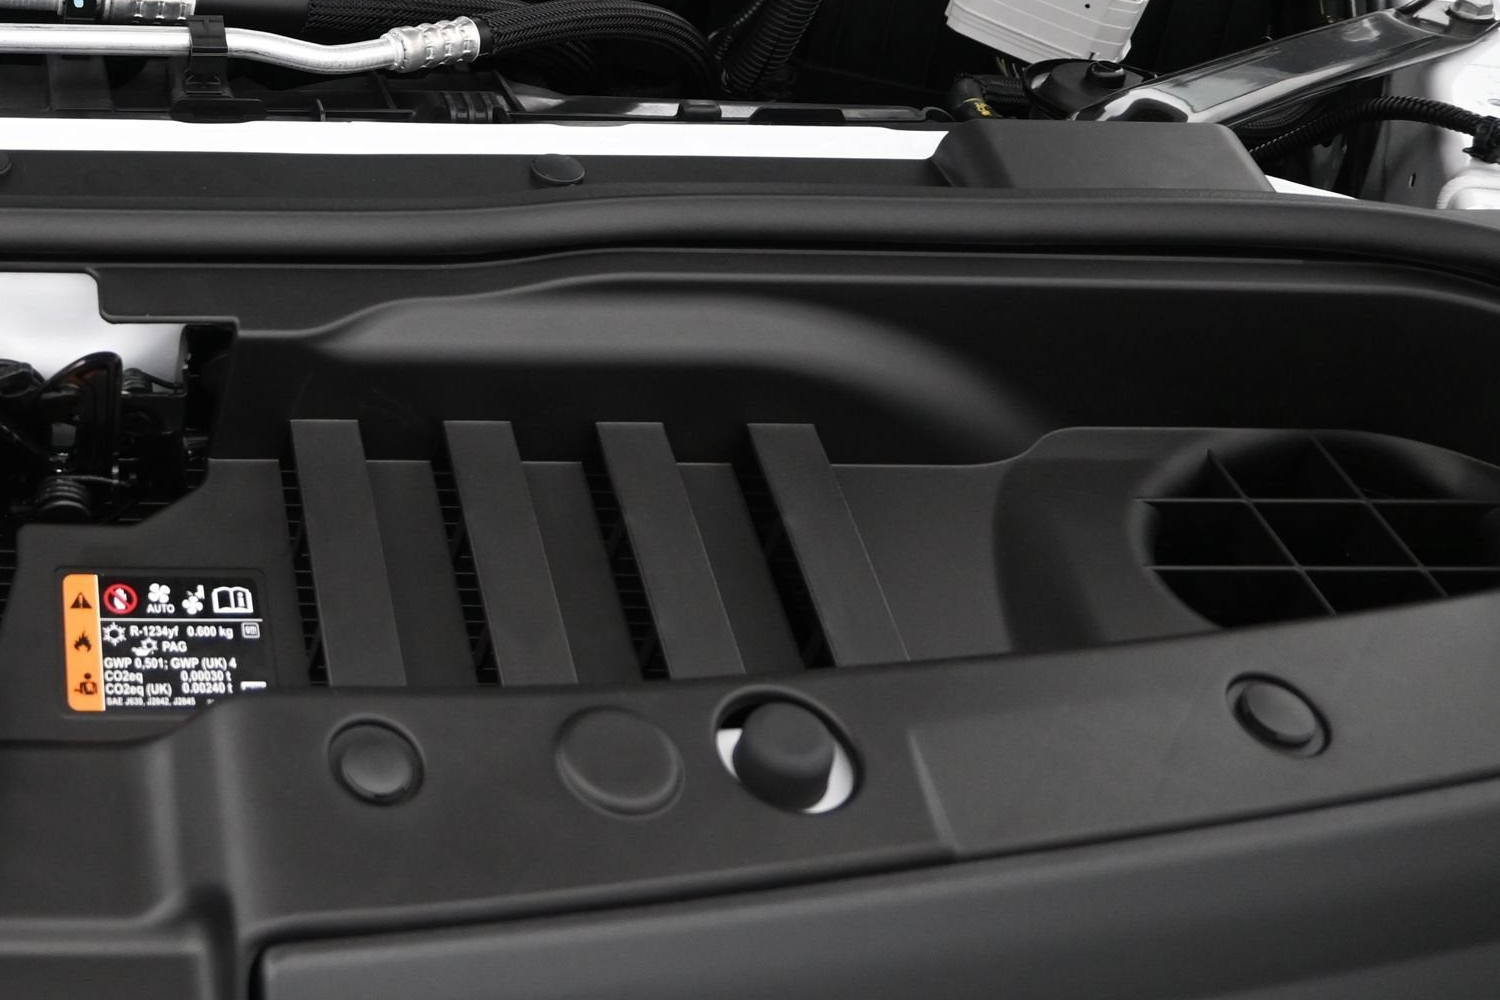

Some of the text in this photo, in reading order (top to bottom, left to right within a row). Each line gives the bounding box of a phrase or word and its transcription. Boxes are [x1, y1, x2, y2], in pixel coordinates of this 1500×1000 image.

[146, 603, 176, 614] AUTO
[129, 624, 234, 640] R-1234yf 0.600 kg
[161, 640, 188, 653] PAG
[103, 656, 237, 672] GWP 0,501; GWP (UK) 4
[104, 669, 144, 684] CO2eq
[225, 670, 232, 682] t
[105, 682, 145, 697] CO2eq
[145, 682, 173, 697] (UK)
[226, 682, 234, 694] t
[105, 696, 124, 706] SAE
